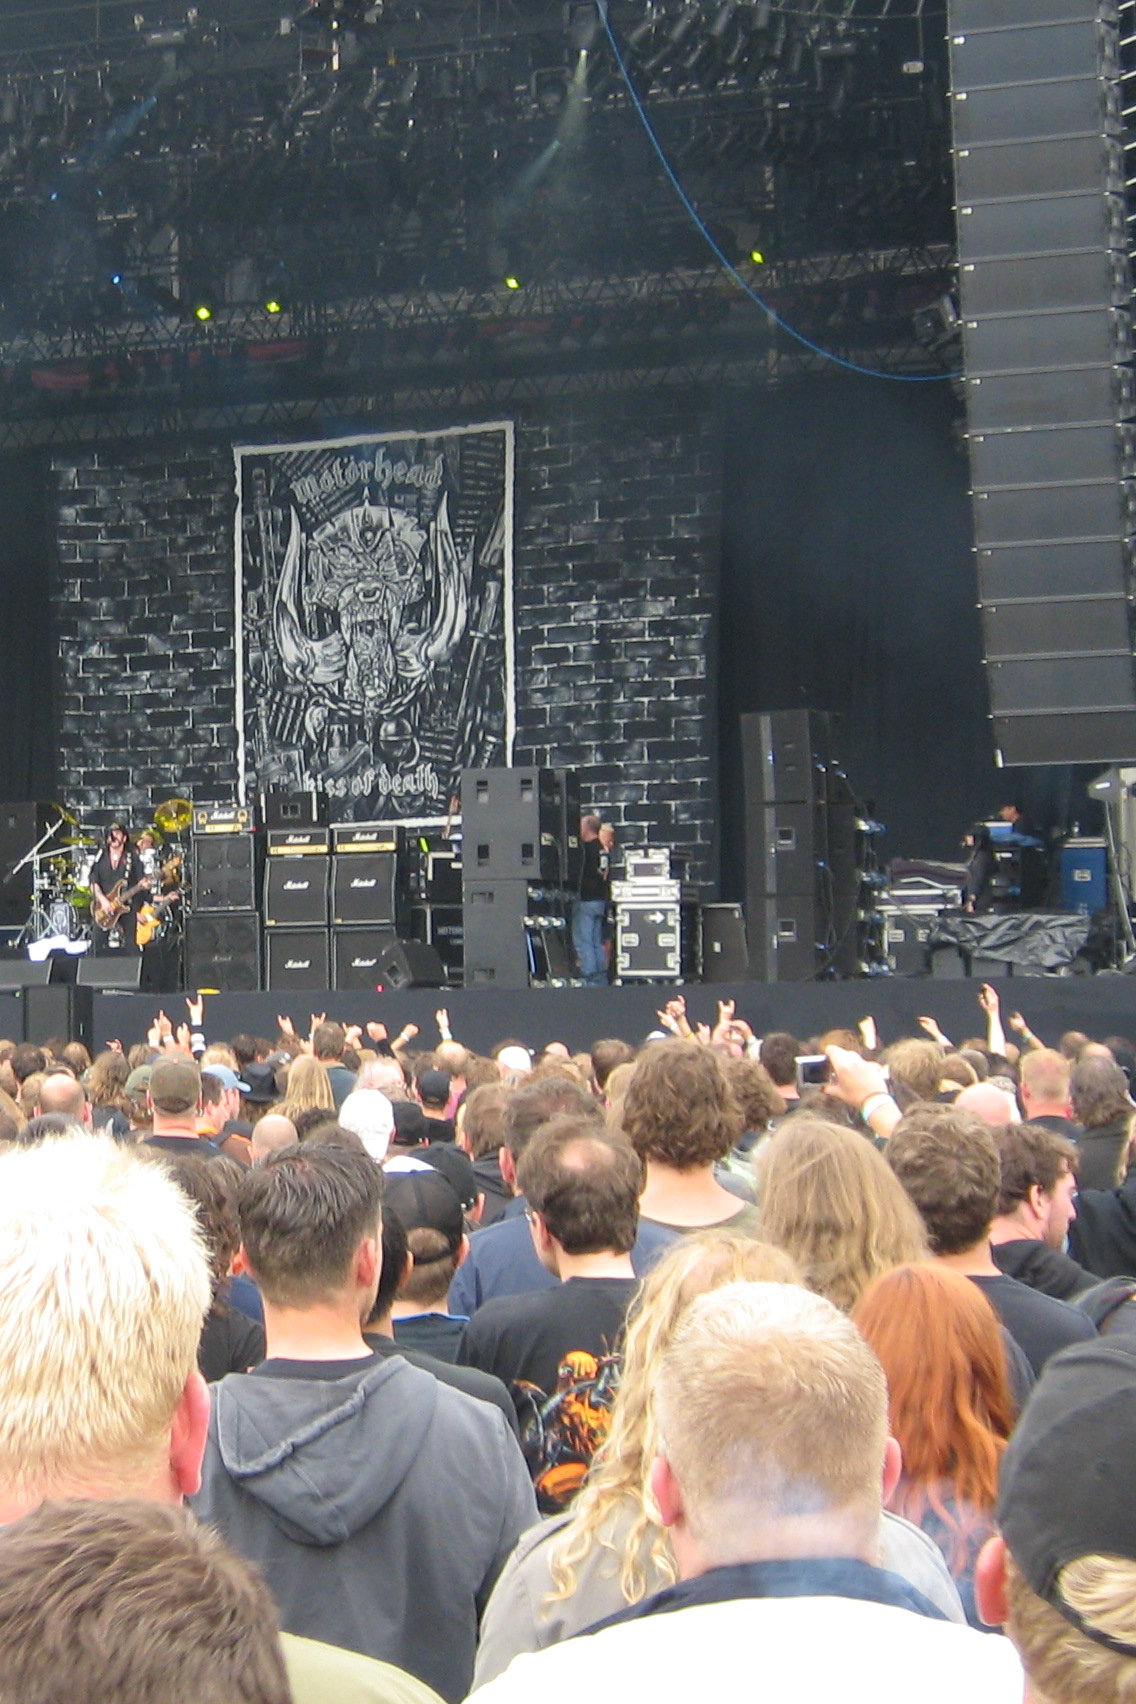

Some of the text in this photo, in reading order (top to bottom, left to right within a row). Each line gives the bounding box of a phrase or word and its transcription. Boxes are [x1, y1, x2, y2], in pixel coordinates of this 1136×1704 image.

[302, 762, 439, 799] kiss of death
